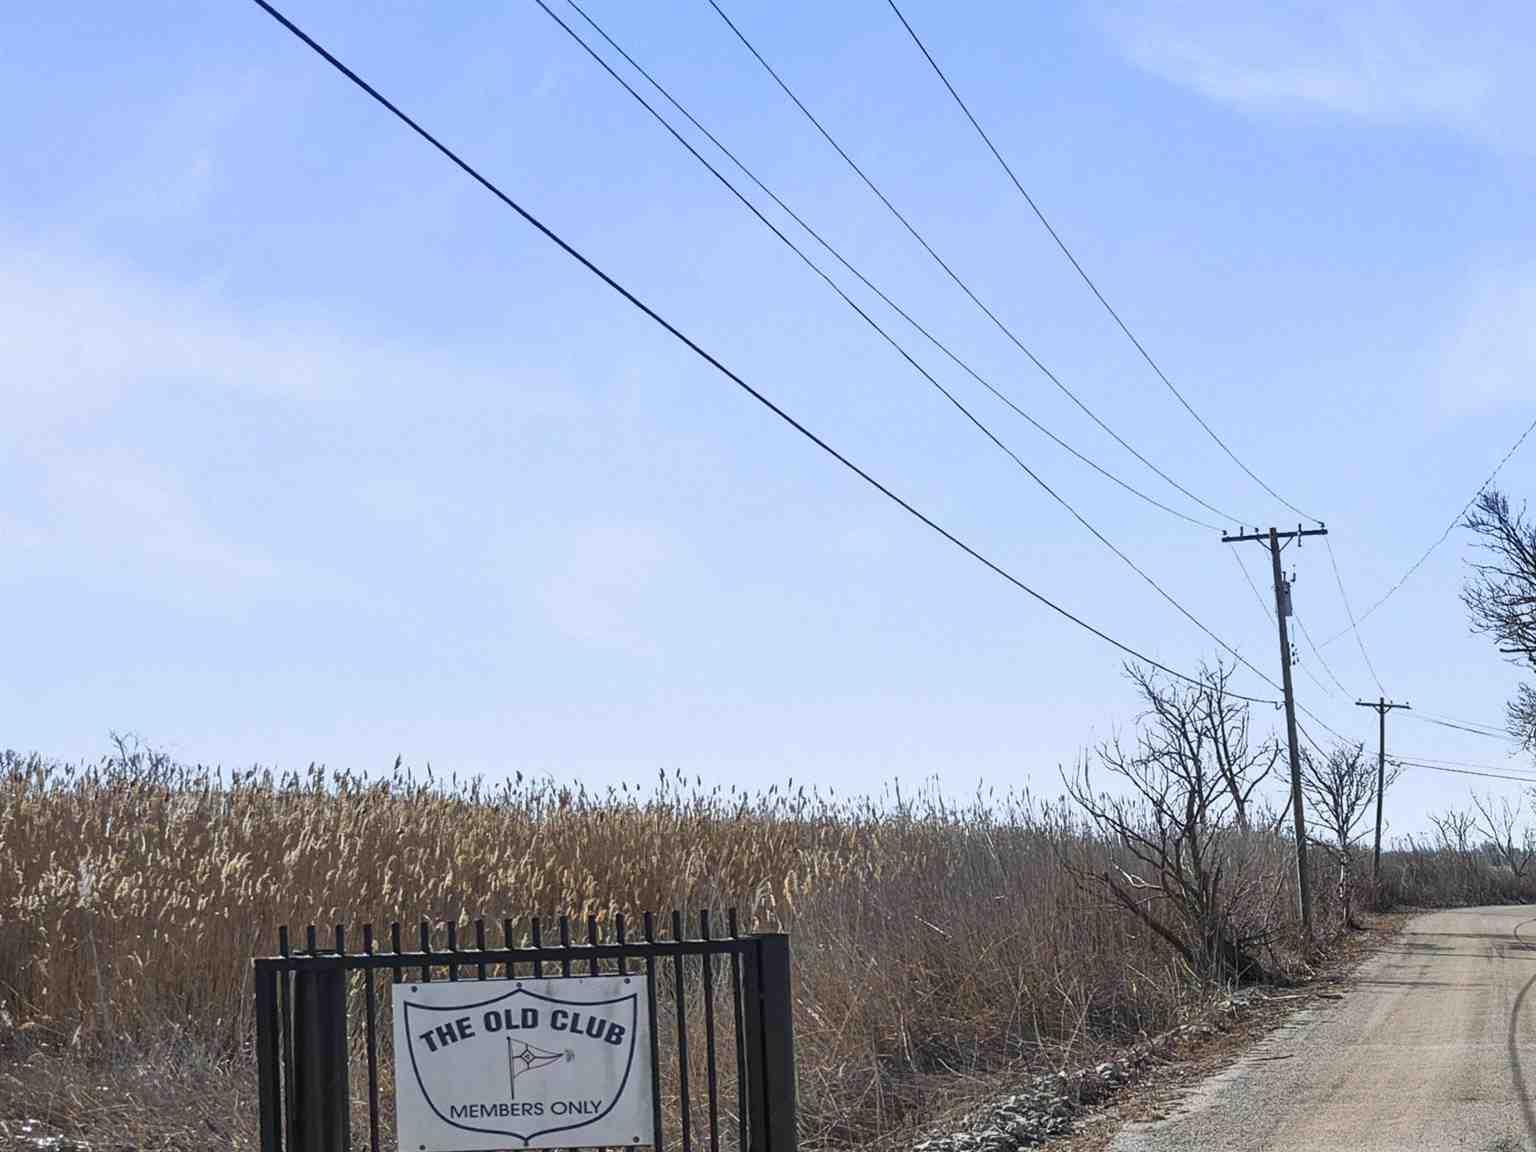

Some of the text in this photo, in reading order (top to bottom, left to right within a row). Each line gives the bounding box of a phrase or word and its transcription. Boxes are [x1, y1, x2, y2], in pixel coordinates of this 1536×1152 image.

[419, 1008, 626, 1052] THE OLD CLUB
[450, 1100, 602, 1119] MEMBERS ONLY
